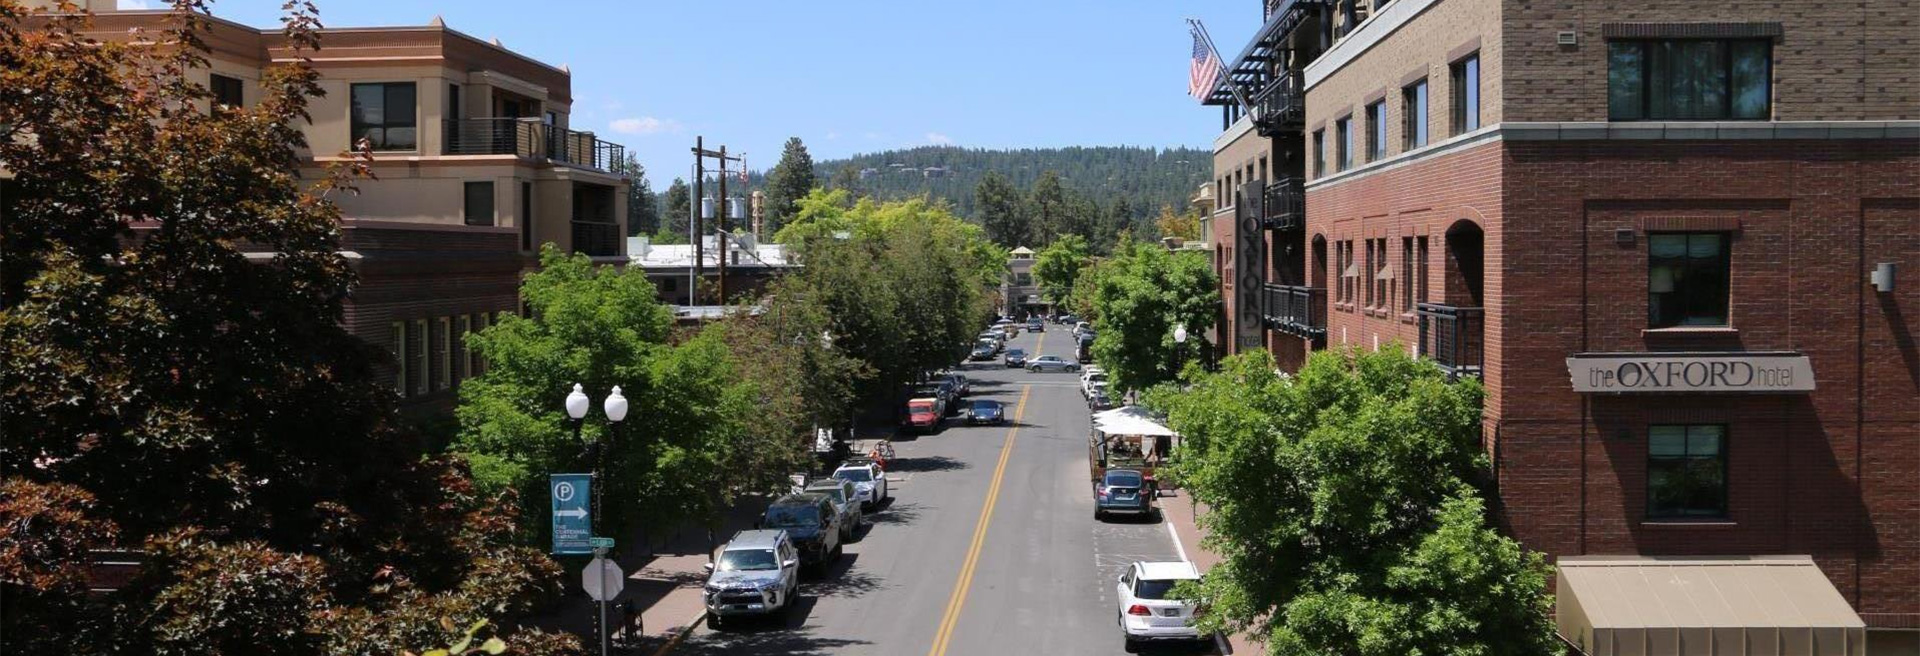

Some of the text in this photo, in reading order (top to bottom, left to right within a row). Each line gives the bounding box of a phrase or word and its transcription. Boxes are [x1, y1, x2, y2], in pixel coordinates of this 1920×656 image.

[1243, 217, 1260, 329] OXFORD
[1589, 361, 1794, 388] the OXFORD hotel
[561, 486, 570, 497] P
